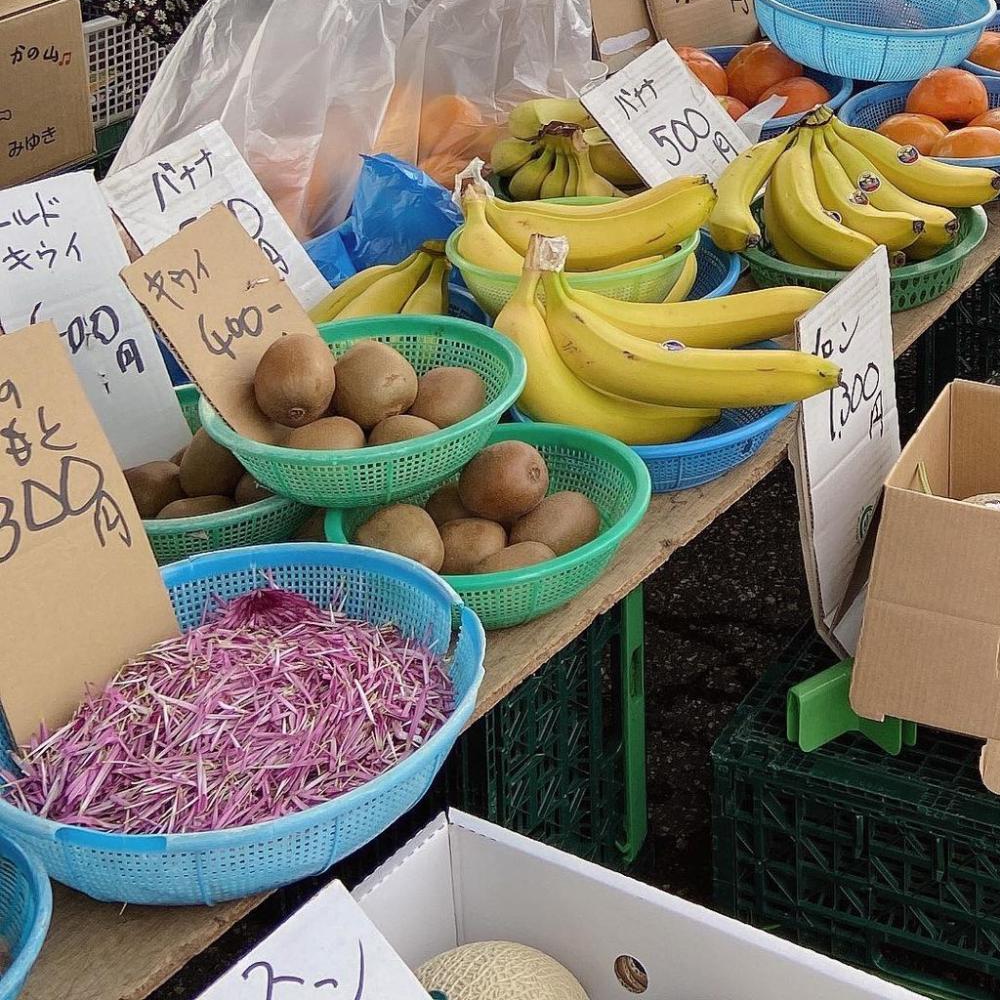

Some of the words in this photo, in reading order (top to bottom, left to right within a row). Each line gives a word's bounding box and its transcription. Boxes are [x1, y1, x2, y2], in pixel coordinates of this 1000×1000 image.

[10, 45, 58, 65] かの山
[614, 78, 658, 121] バナナ
[8, 126, 57, 158] みゆき
[152, 149, 212, 213] バナナ
[3, 231, 82, 271] キウイ
[143, 248, 210, 310] キウイ
